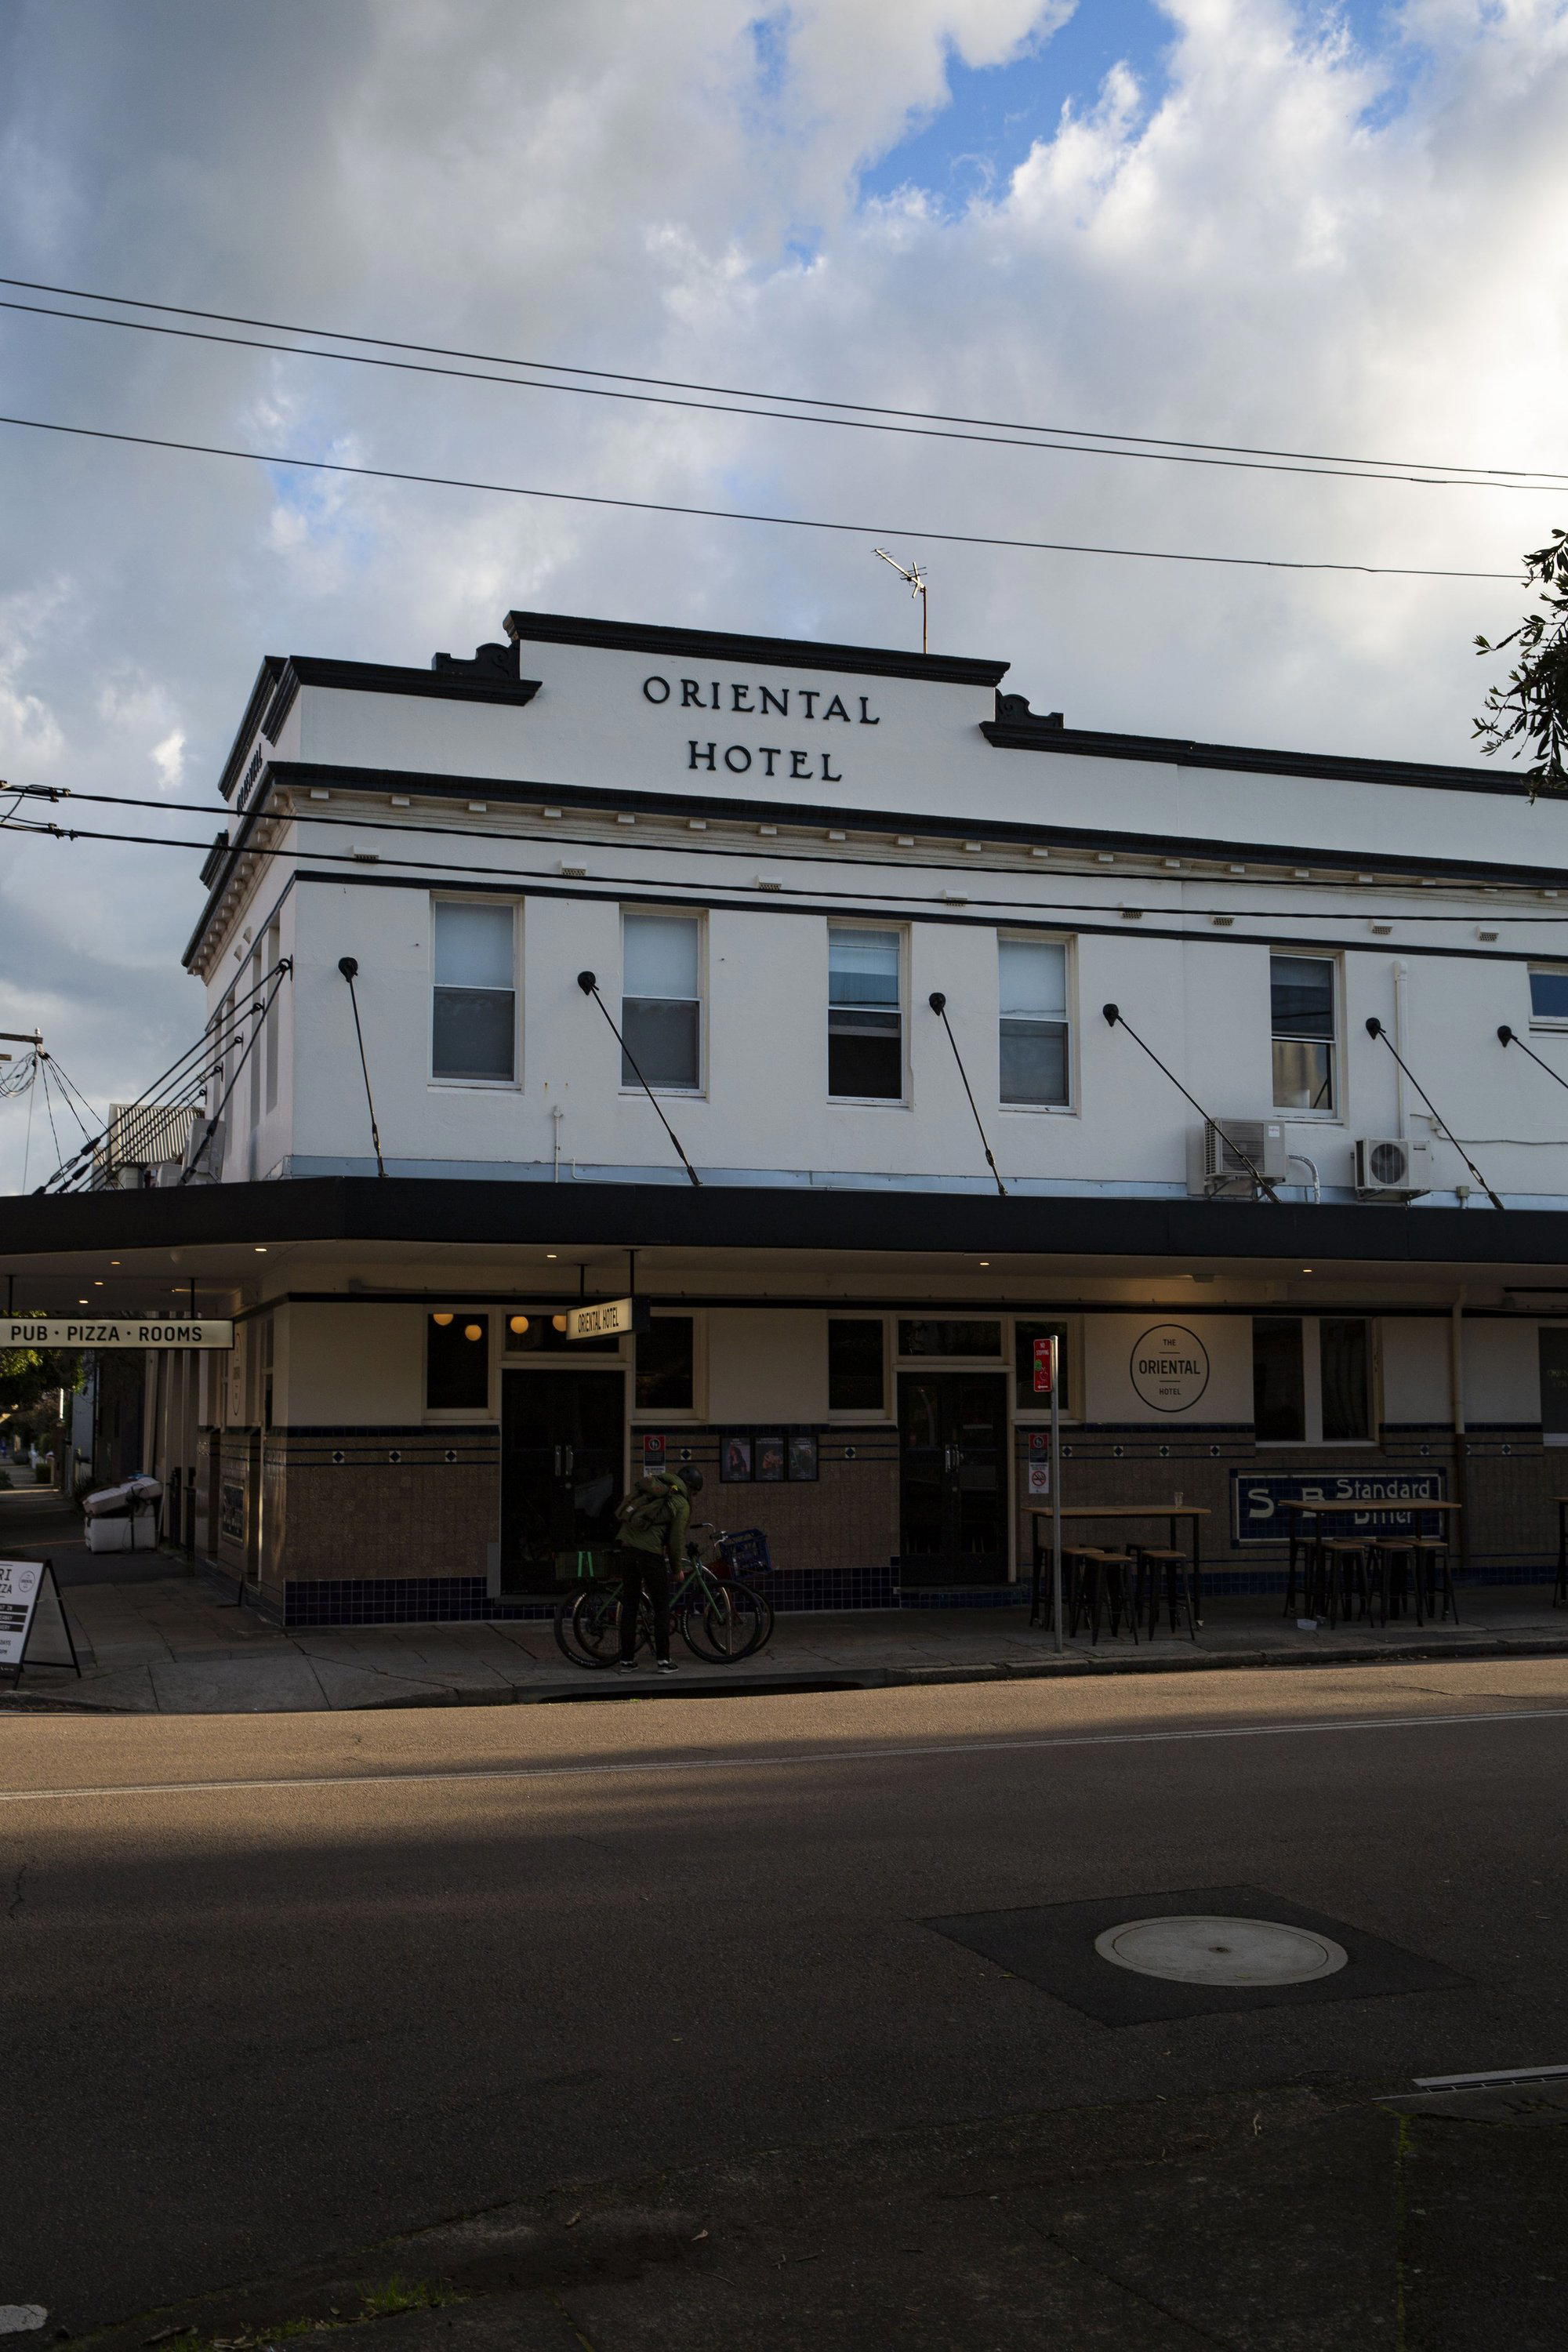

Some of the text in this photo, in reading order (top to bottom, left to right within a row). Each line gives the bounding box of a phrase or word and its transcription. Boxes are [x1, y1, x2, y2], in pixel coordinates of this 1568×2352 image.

[643, 676, 880, 724] ORIENTAL
[688, 741, 842, 782] HOTEL
[578, 1307, 619, 1333] ORIENTAL HOTEL
[11, 1326, 202, 1341] PUB PIZZA ROOMS
[1138, 1360, 1200, 1374] ORIENTAL
[1336, 1479, 1430, 1499] Standard
[1248, 1488, 1275, 1518] S
